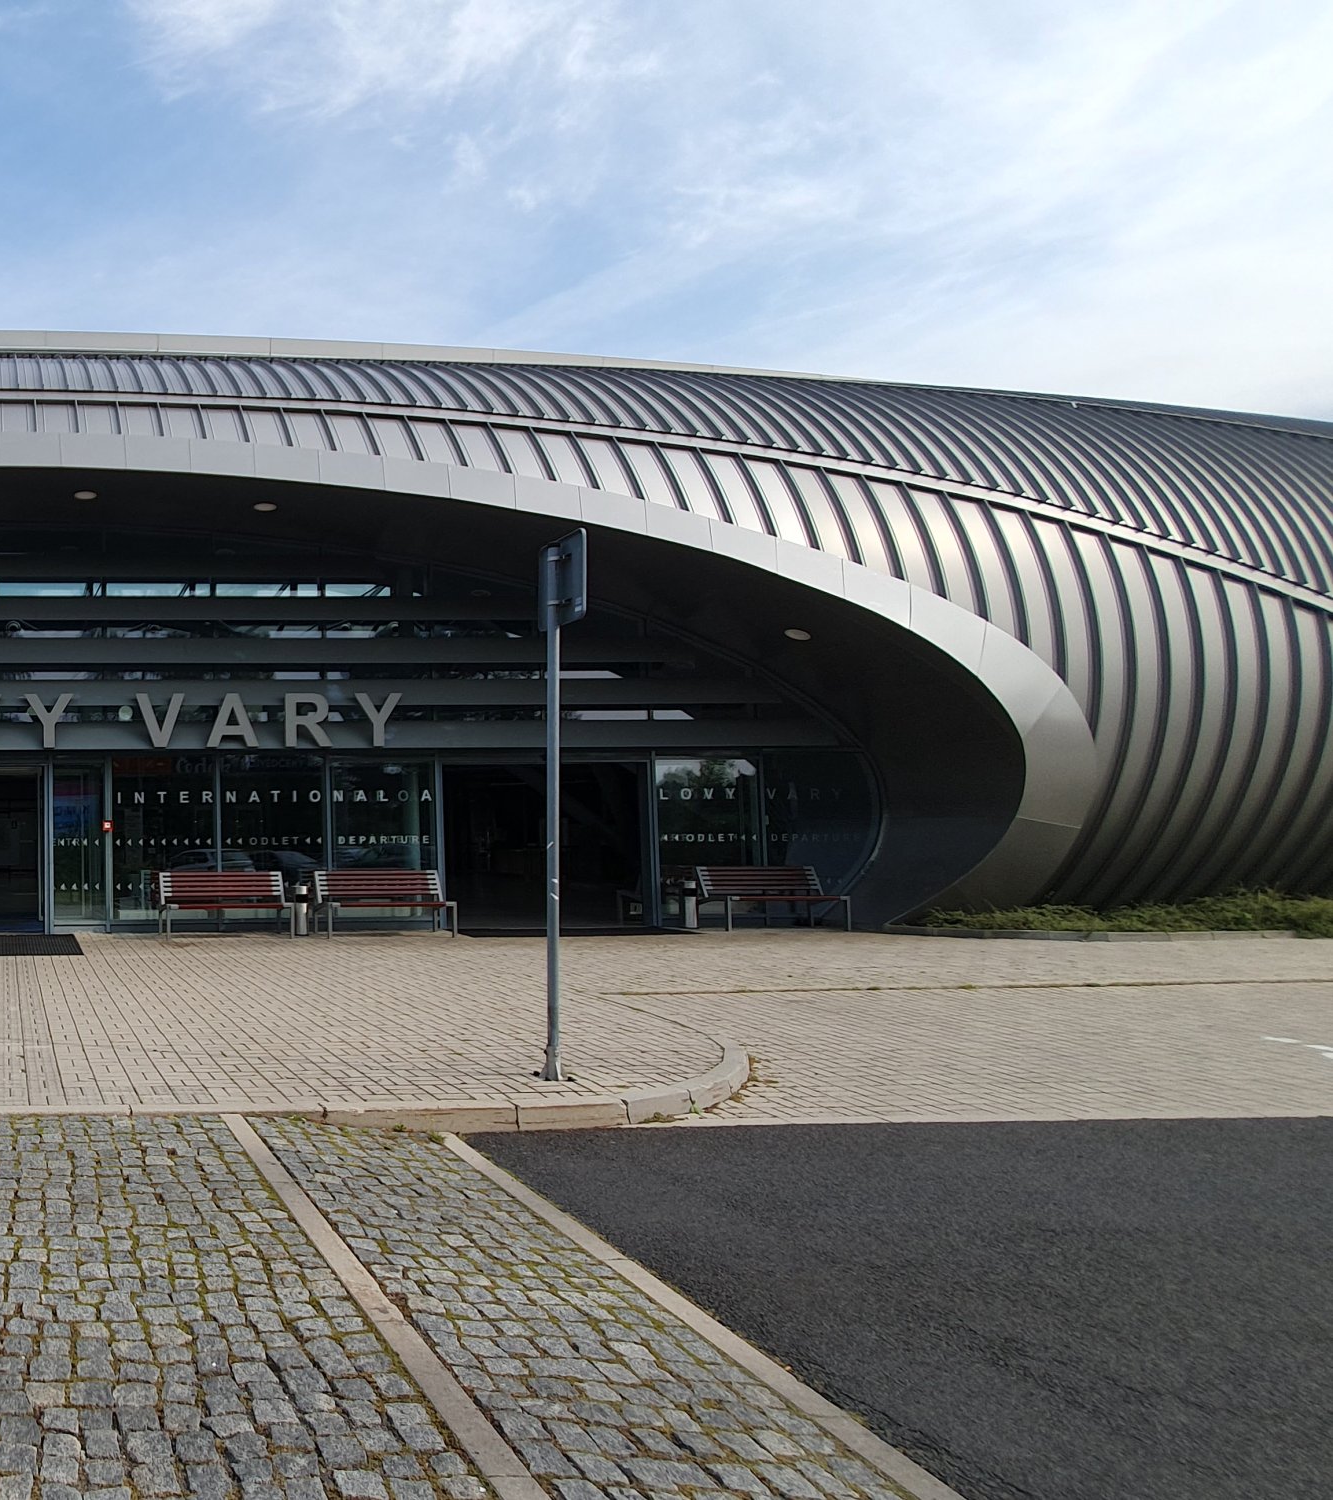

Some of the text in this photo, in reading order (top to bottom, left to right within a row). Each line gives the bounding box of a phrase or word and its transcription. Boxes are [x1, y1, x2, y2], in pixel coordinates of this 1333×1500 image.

[135, 692, 402, 748] VARY
[766, 787, 843, 800] VARY
[249, 836, 299, 846] ODLET
